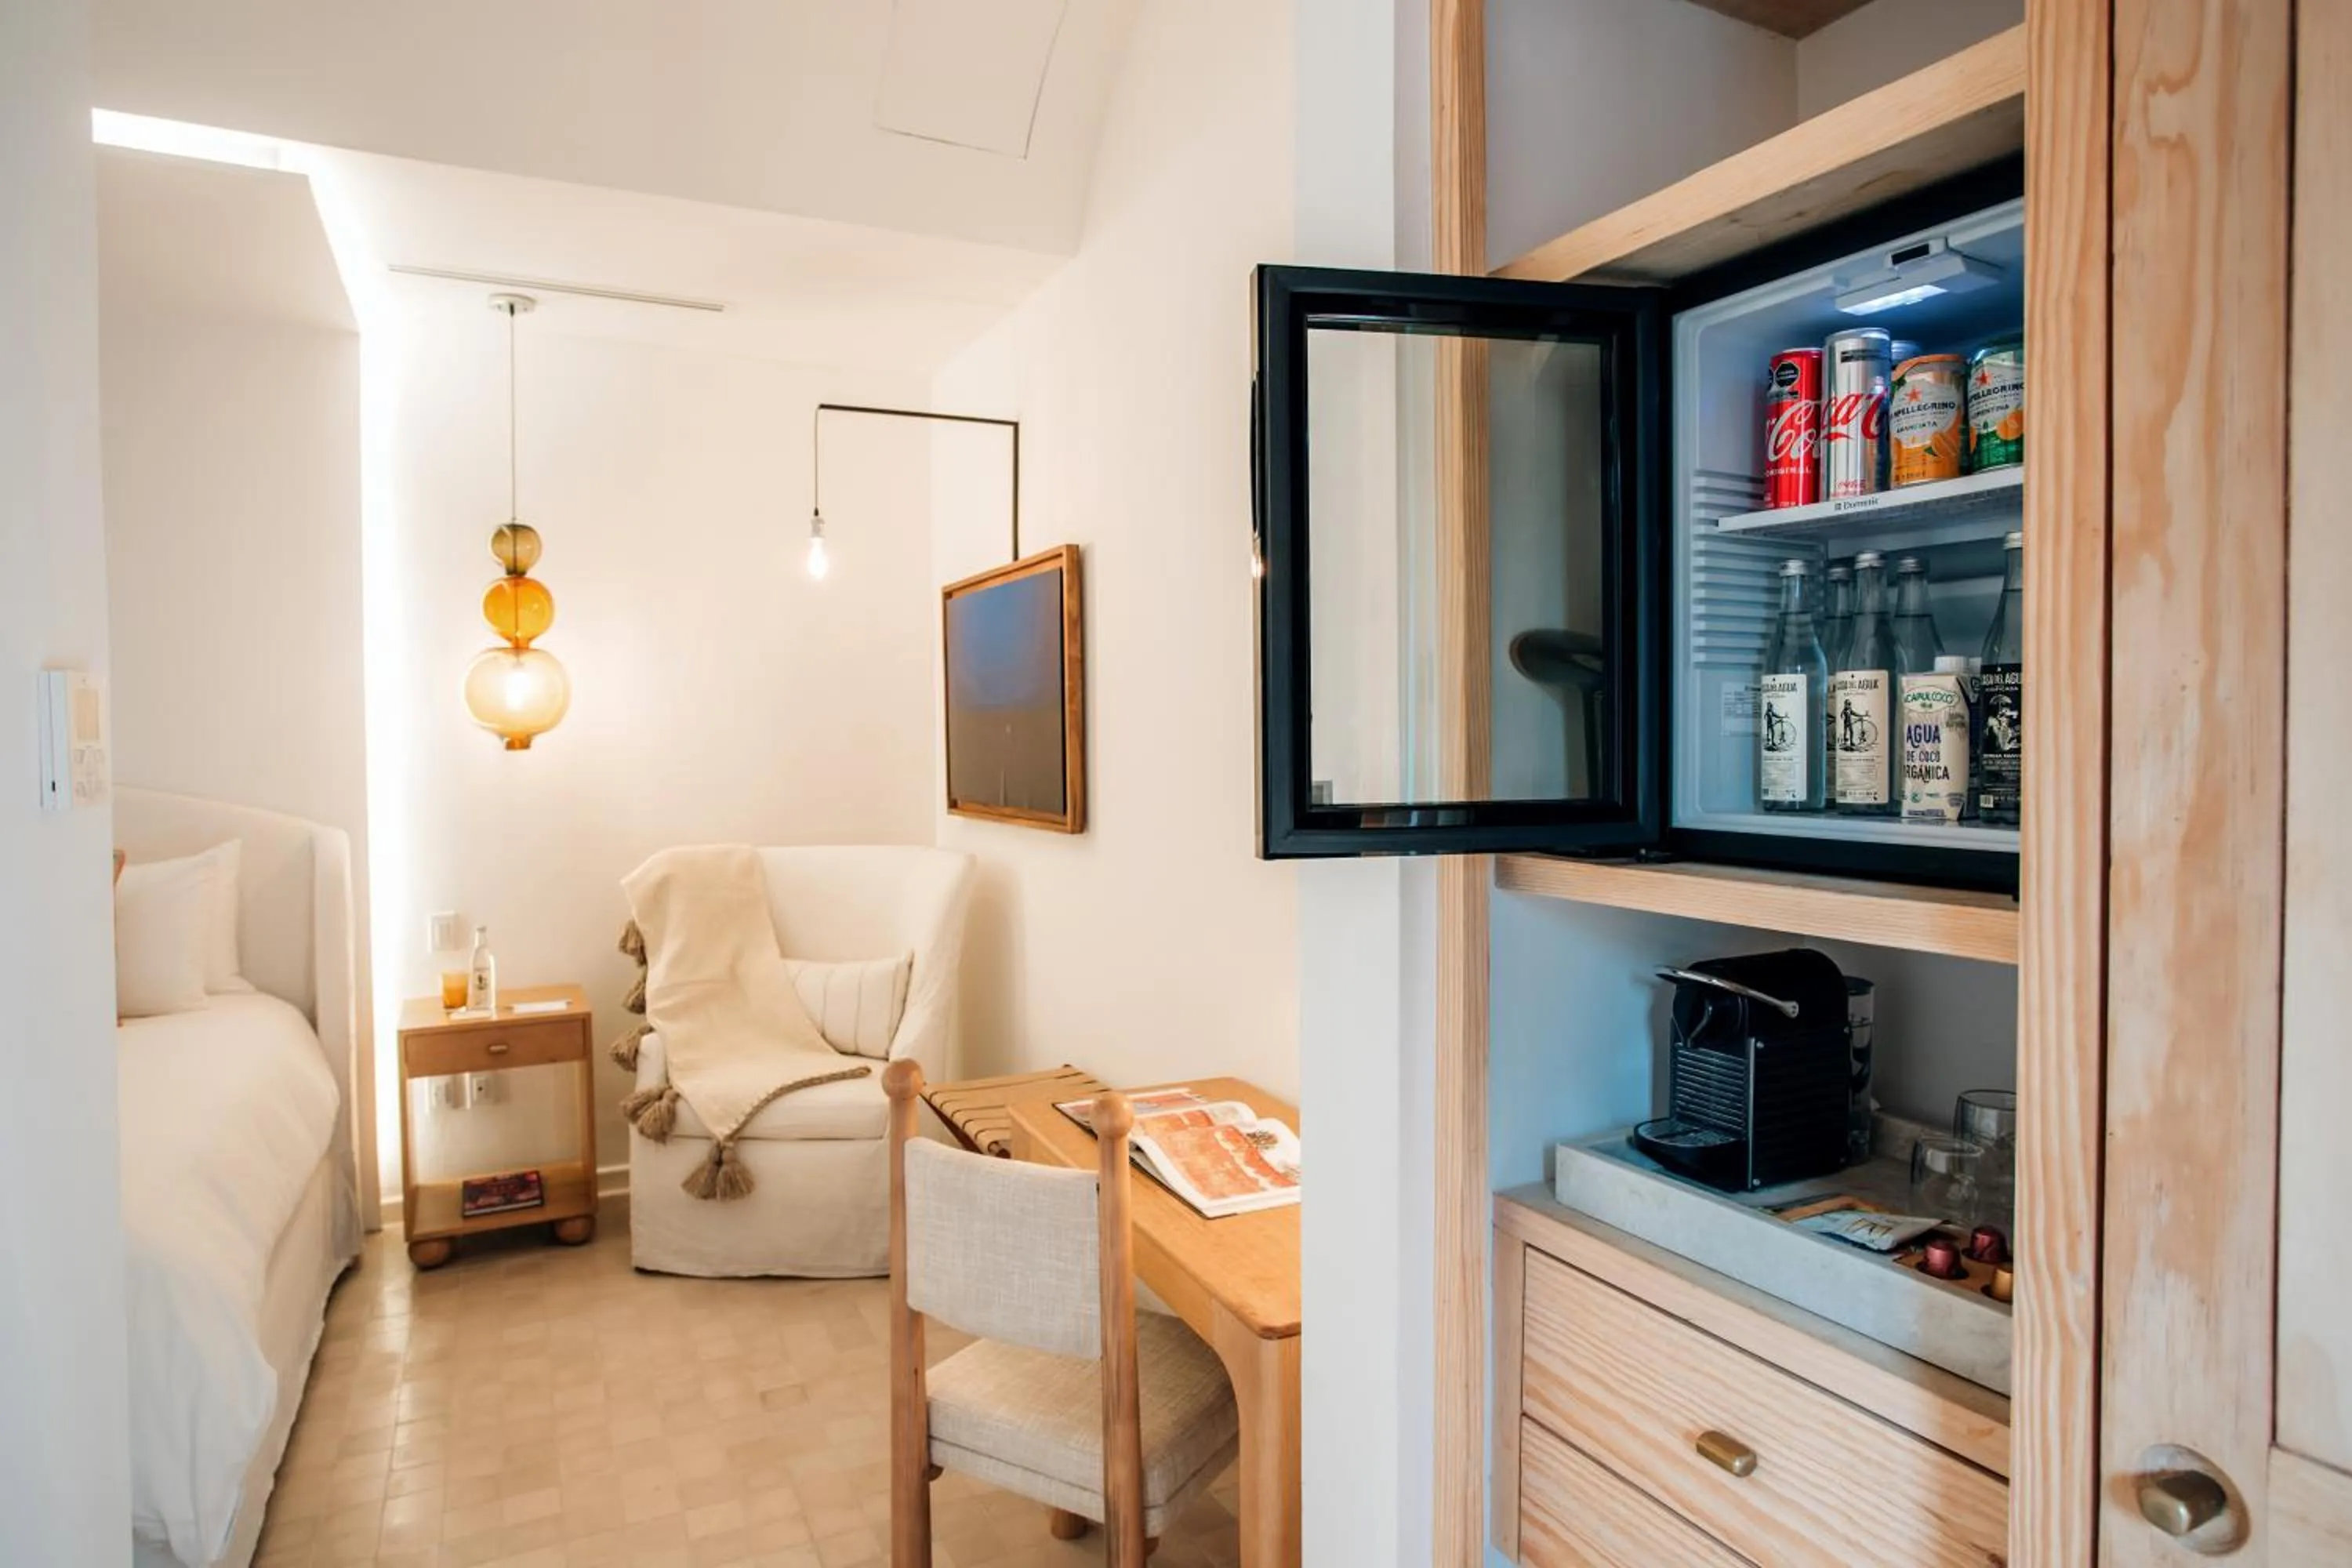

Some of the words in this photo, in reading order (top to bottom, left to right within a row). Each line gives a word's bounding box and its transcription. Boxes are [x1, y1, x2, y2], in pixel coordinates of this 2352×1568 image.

[1906, 724, 1941, 749] AGUA
[1906, 750, 1915, 763] DE
[1918, 750, 1941, 763] COCO
